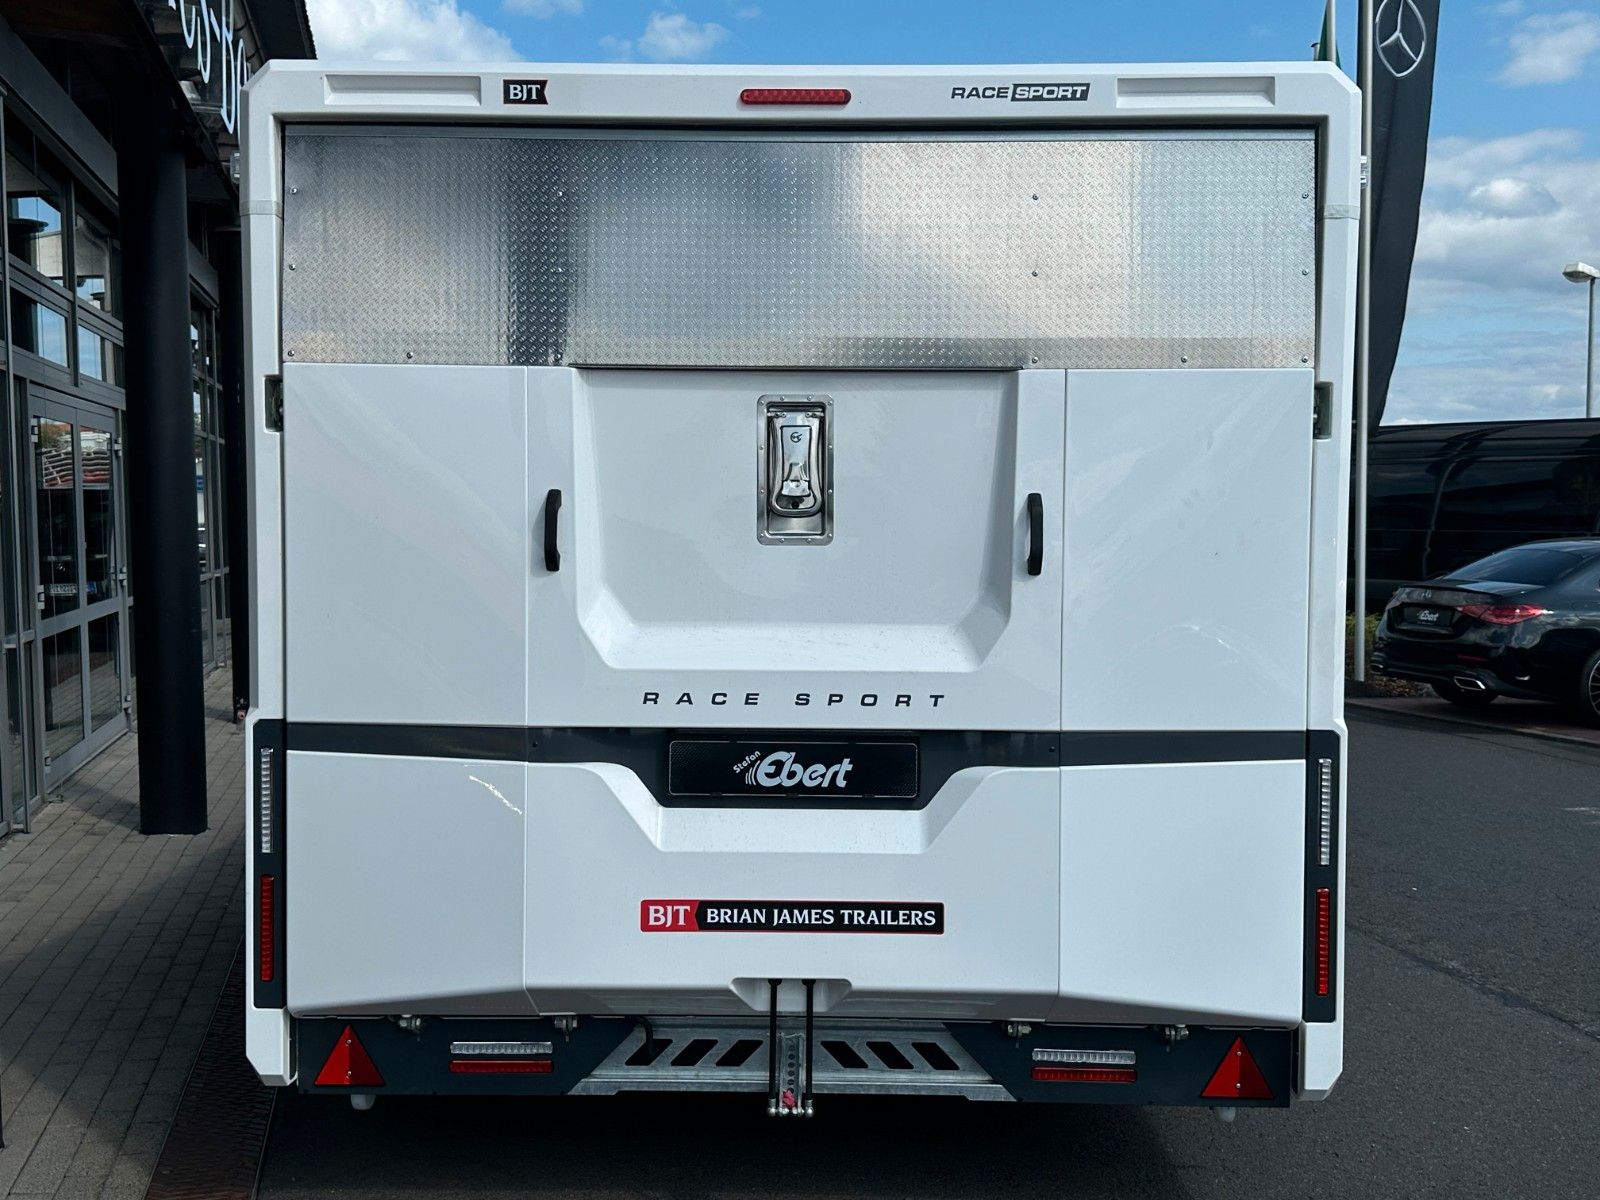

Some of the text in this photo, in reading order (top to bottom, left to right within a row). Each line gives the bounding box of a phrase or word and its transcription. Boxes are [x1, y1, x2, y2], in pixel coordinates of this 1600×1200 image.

[509, 84, 541, 101] BJT
[951, 86, 1087, 99] RACE SPORT
[642, 692, 945, 707] RACE SPORT
[732, 750, 761, 774] Stefan
[756, 750, 853, 788] Ebert
[648, 905, 691, 928] BJT
[706, 908, 936, 926] BRIAN JAMES TRAILERS
